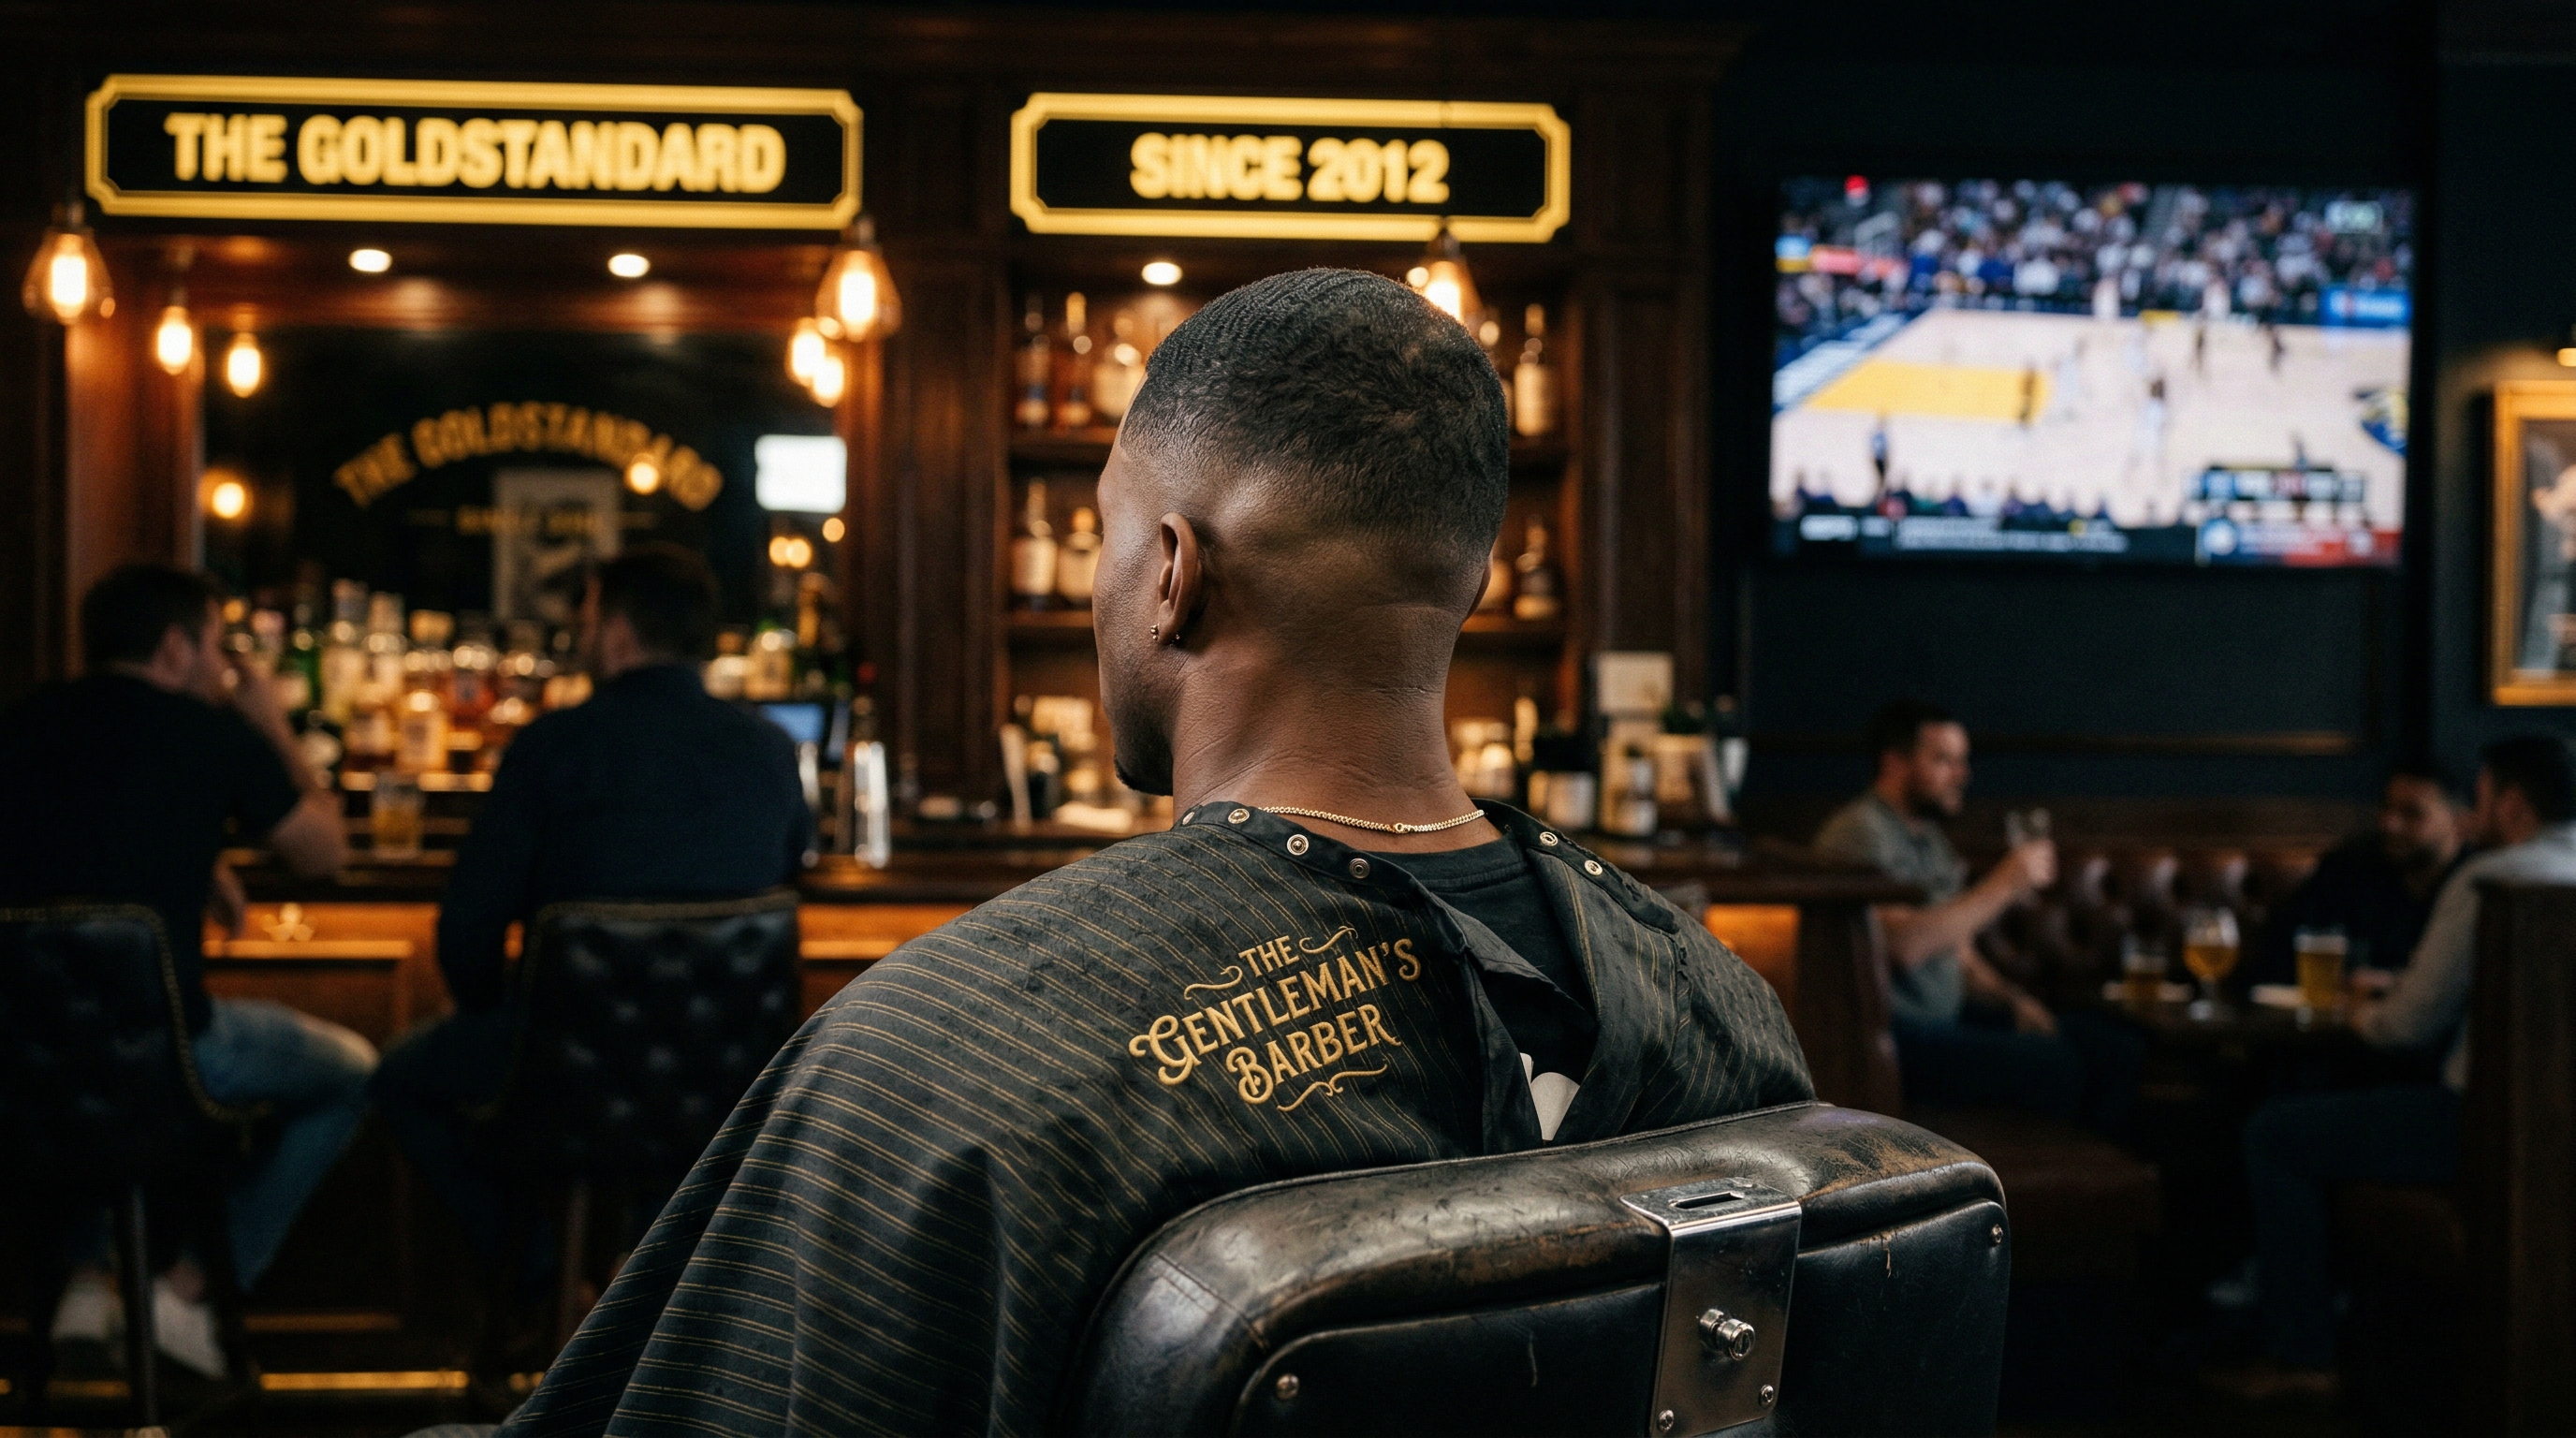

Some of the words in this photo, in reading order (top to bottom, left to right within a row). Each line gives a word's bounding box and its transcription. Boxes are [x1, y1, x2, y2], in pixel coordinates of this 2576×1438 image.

[164, 112, 288, 183] THE
[297, 113, 787, 194] GOLDSTANDARD
[1129, 132, 1304, 203] SINCE
[1307, 138, 1451, 204] 2012
[1239, 935, 1301, 978] THE
